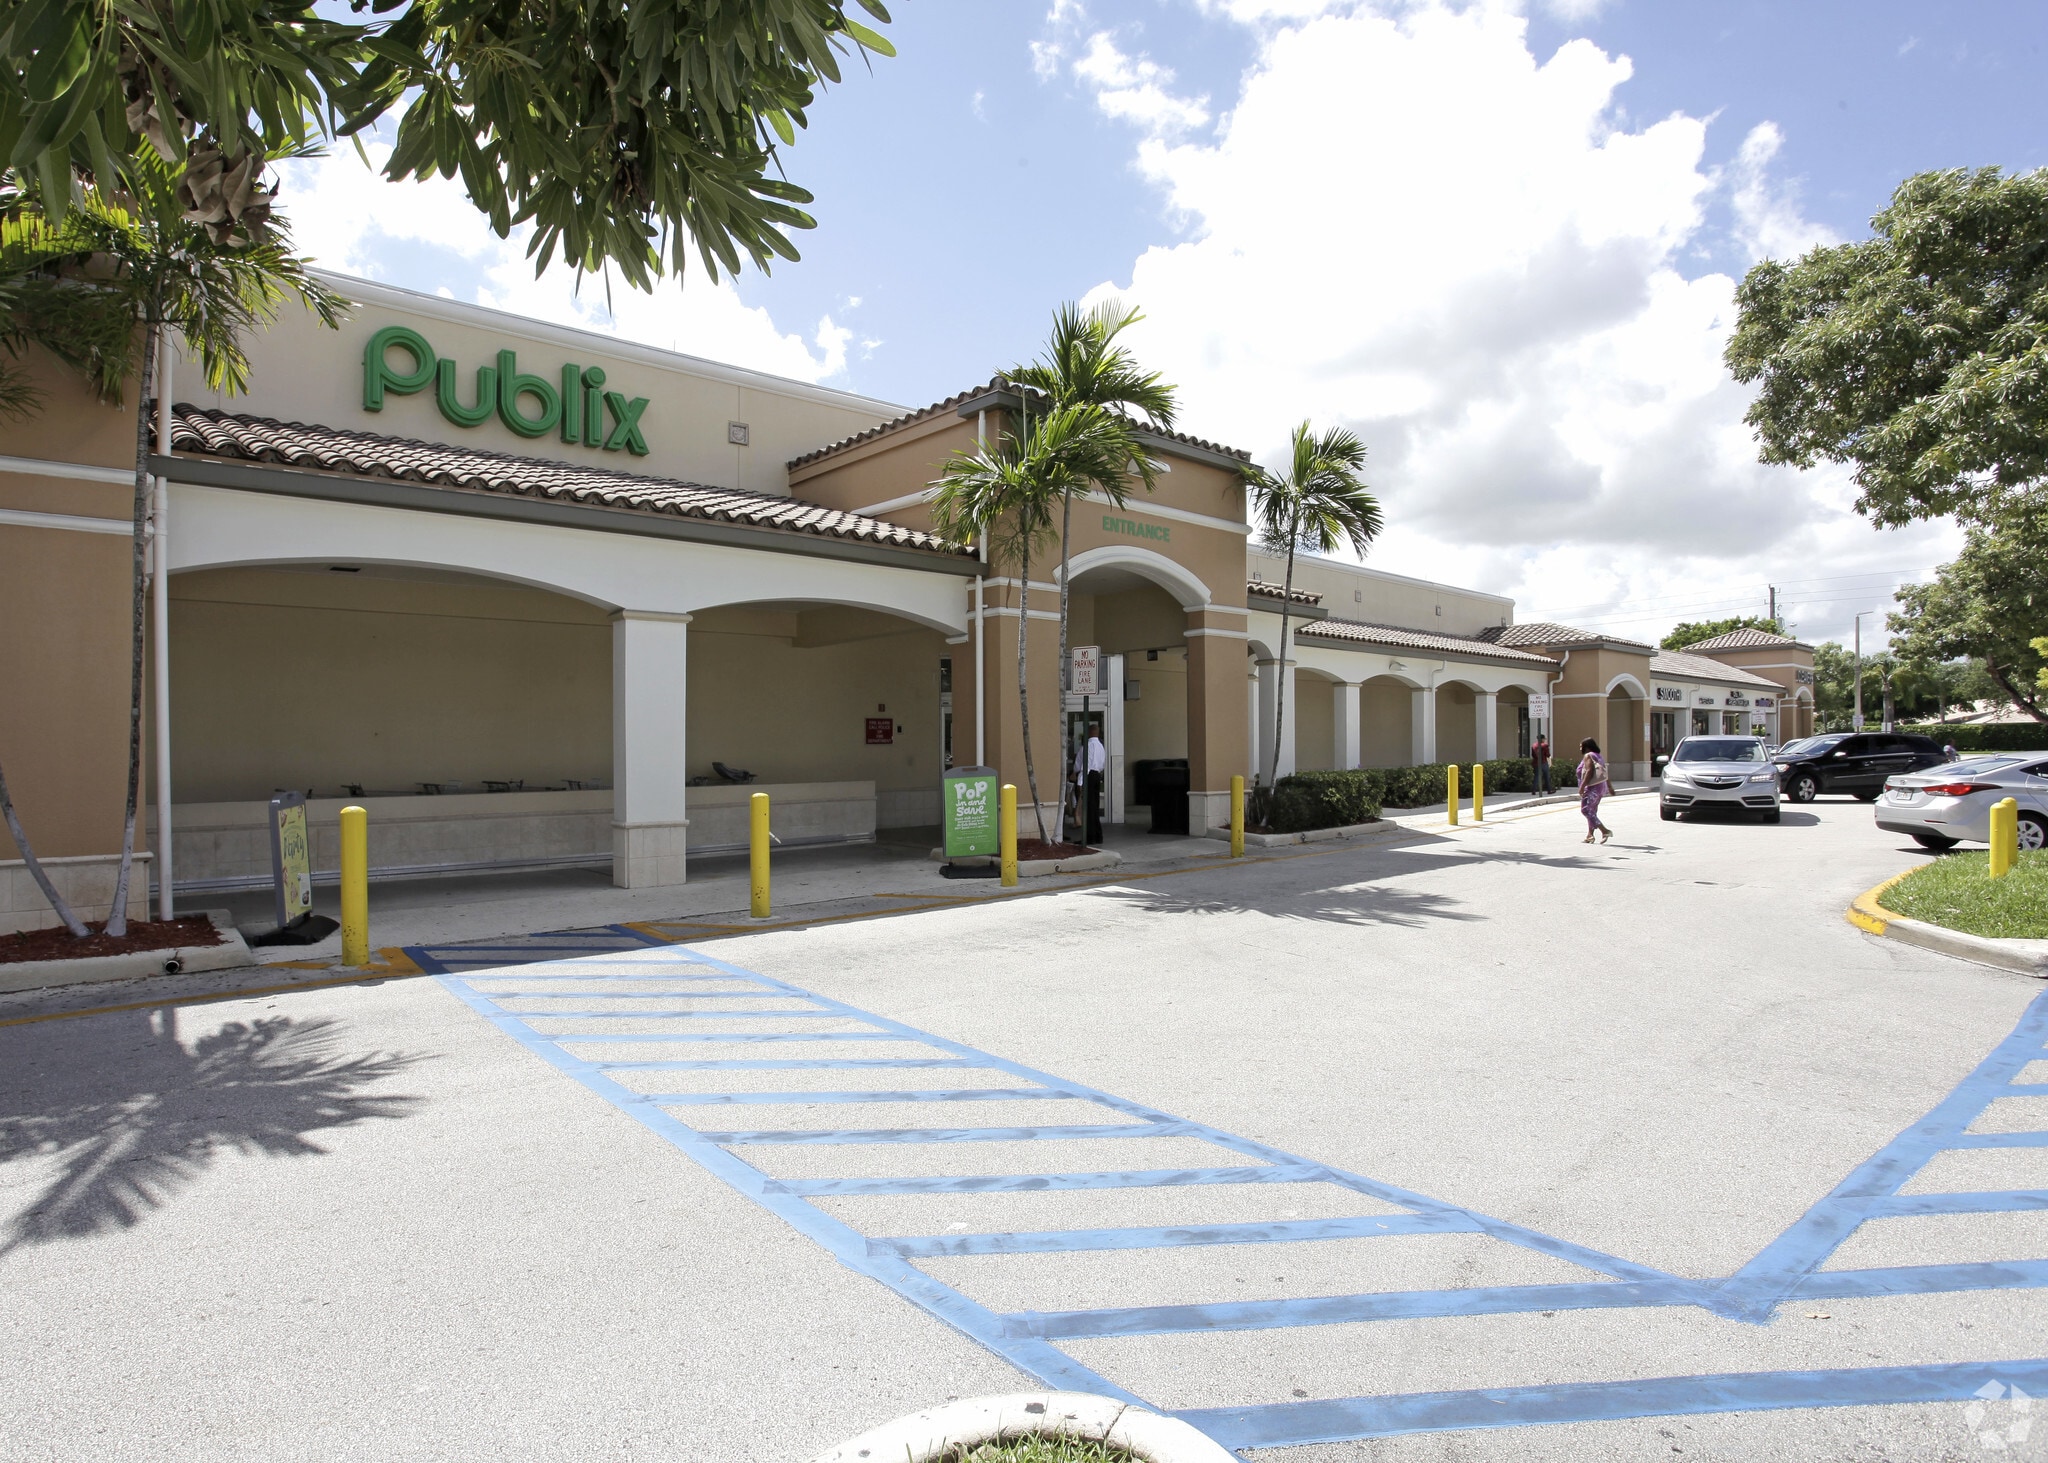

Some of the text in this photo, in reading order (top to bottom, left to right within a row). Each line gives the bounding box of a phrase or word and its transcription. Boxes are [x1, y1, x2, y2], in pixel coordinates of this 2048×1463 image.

[363, 326, 650, 457] Publix
[1102, 515, 1171, 543] ENTRANCE
[1081, 650, 1088, 659] NO
[1074, 659, 1096, 669] PARKING
[968, 796, 986, 806] and
